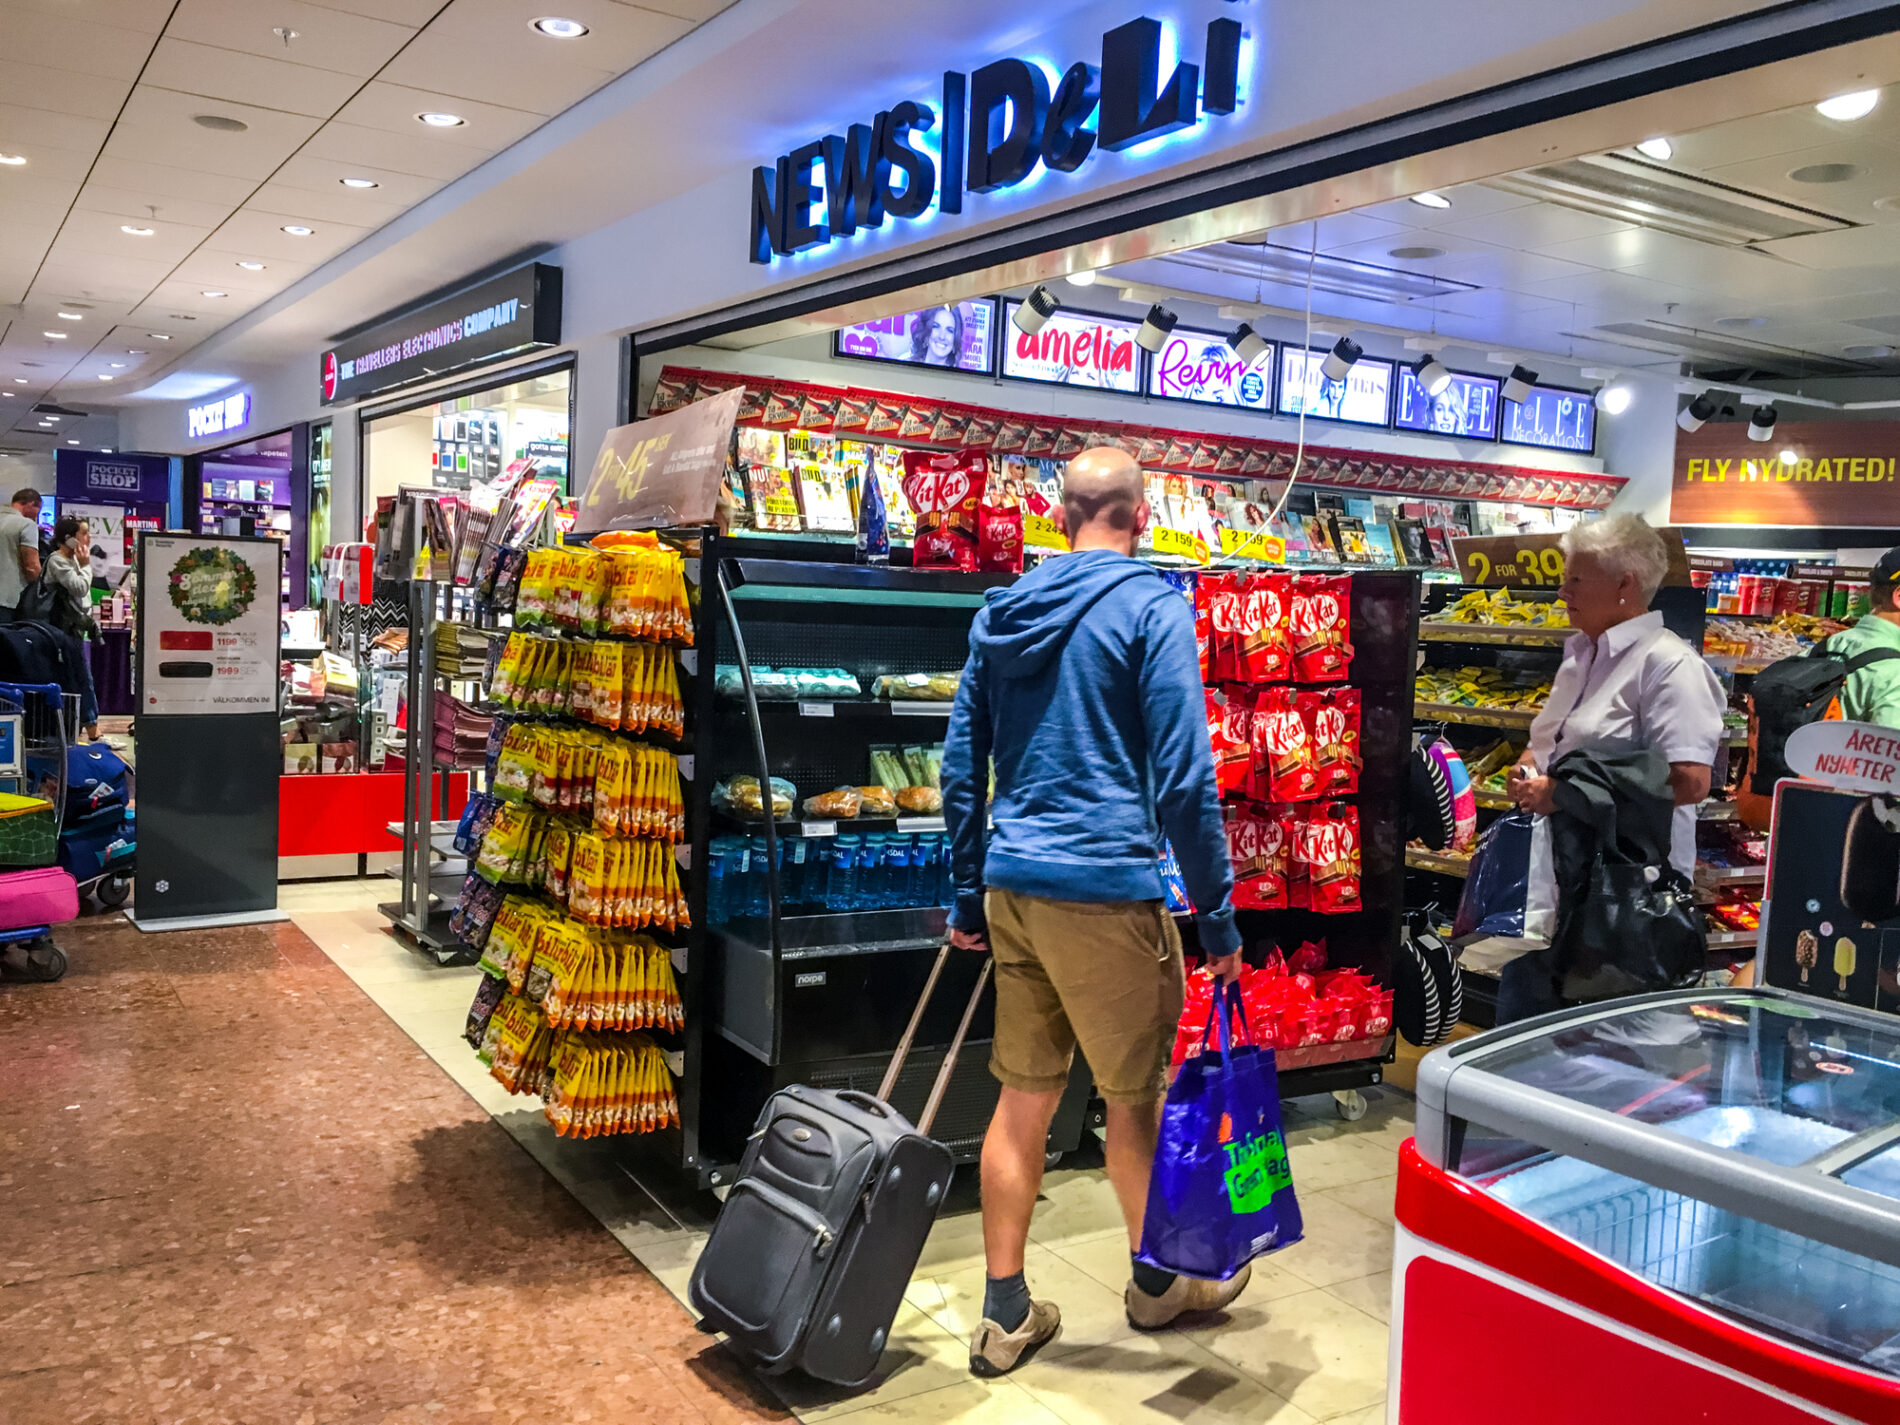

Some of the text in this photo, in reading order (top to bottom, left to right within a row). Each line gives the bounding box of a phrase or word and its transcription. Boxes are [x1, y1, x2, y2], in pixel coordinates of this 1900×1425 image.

[750, 100, 936, 265] NEWS
[341, 360, 354, 380] THE
[402, 319, 462, 359] ELECTRONICS
[464, 298, 519, 337] COMPANY
[1016, 325, 1132, 372] amelia
[1400, 374, 1494, 433] ELE
[1511, 427, 1585, 449] DECORATION
[90, 473, 136, 488] SHOP
[91, 465, 136, 476] POCKET
[587, 447, 615, 506] 2
[1687, 457, 1896, 482] FLY HYDRATED!
[909, 472, 962, 514] KitKat
[126, 519, 158, 529] MARTINA
[1161, 530, 1192, 547] 2 159
[1231, 531, 1238, 542] 2
[1468, 548, 1565, 585] 2 FOR 39
[1238, 592, 1278, 633] KitKat
[1294, 598, 1334, 632] KiKat
[1815, 753, 1896, 783] NYHETER
[1231, 822, 1278, 858] KitKat
[1314, 823, 1347, 865] KitK
